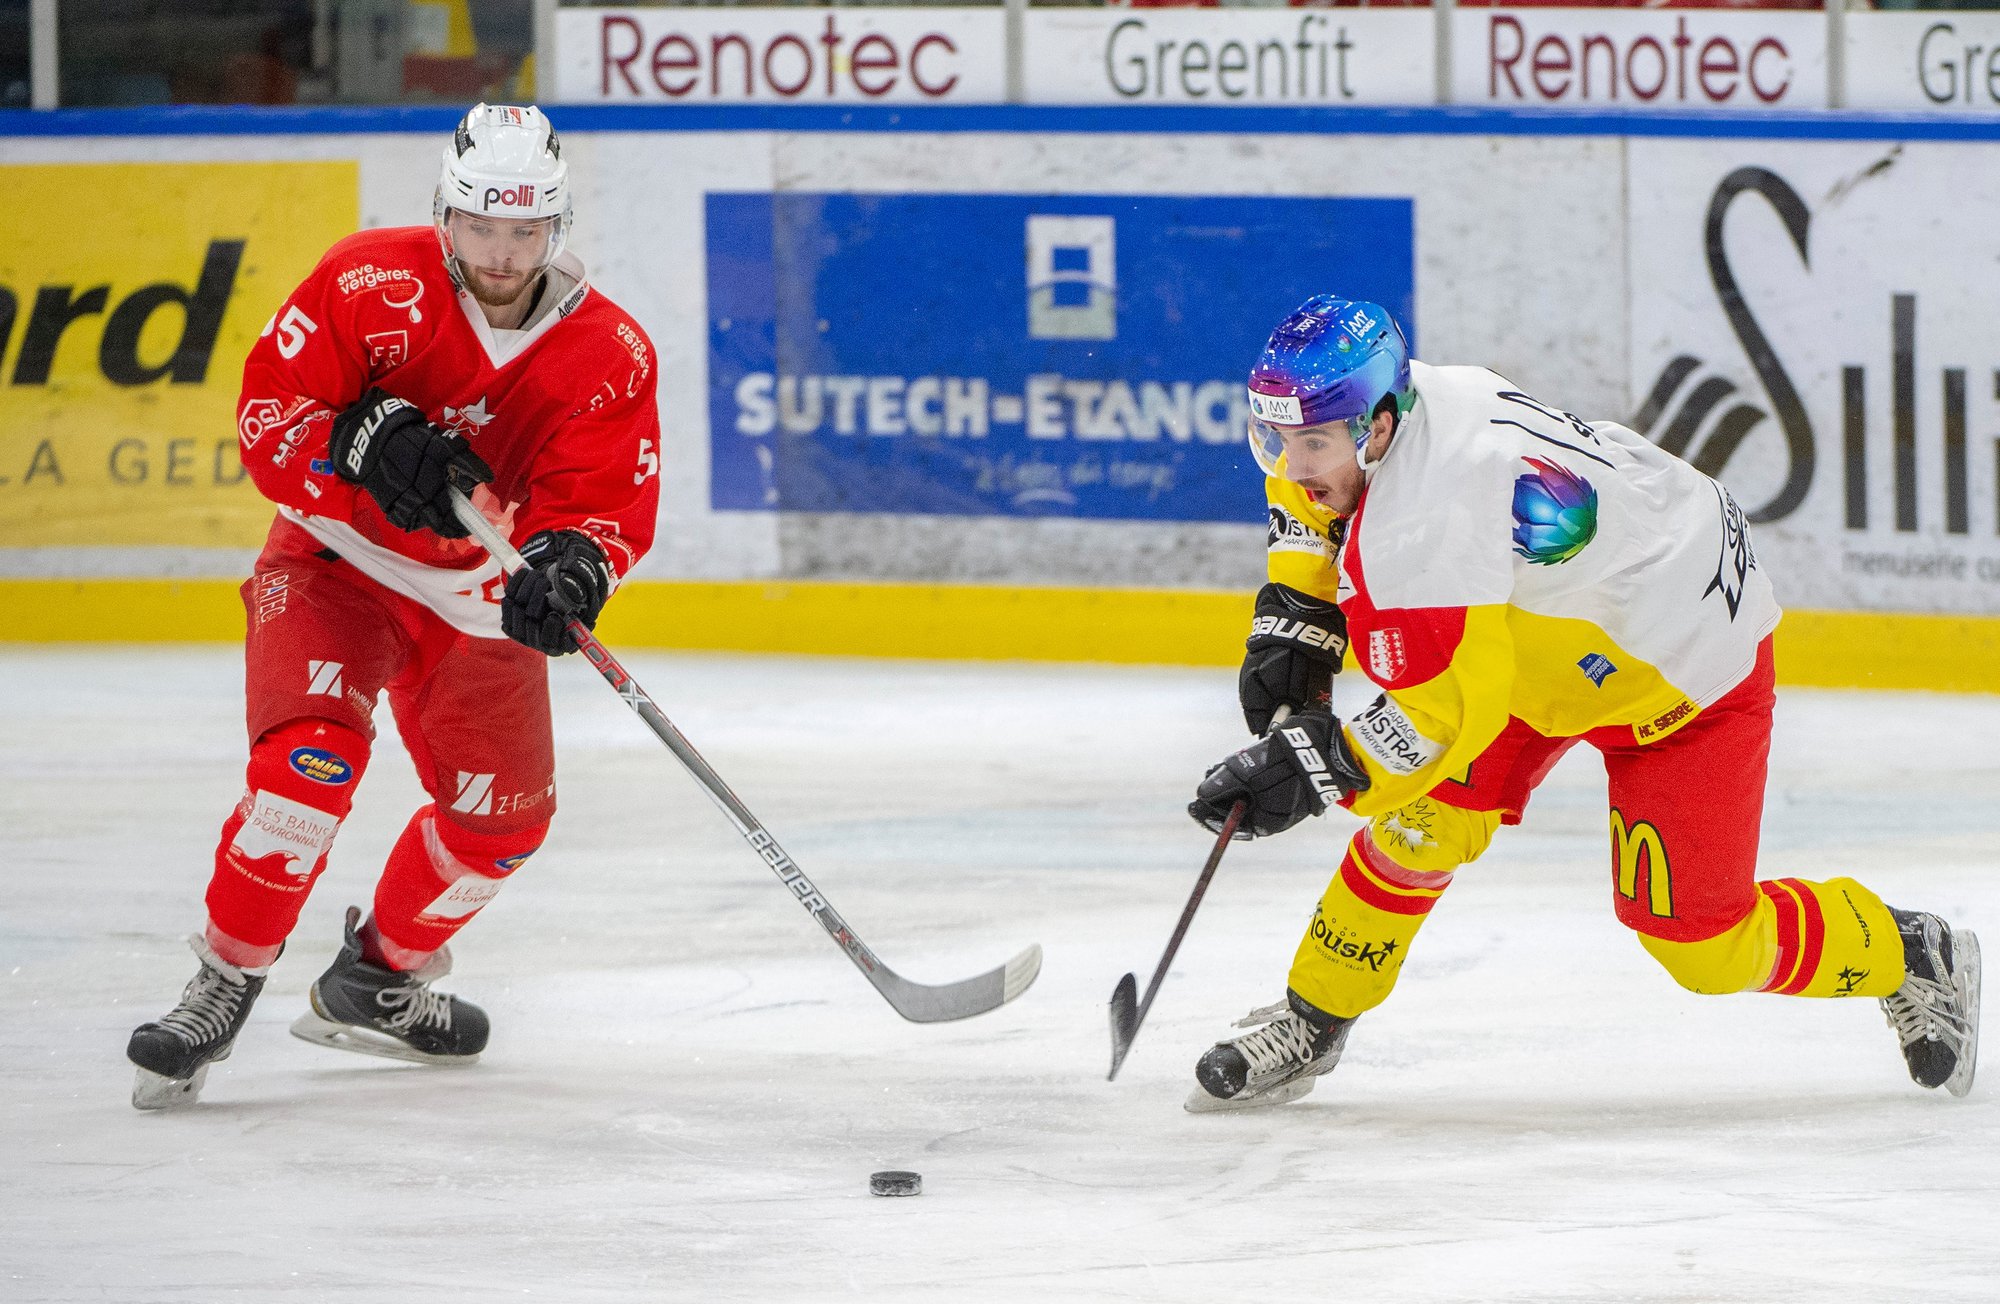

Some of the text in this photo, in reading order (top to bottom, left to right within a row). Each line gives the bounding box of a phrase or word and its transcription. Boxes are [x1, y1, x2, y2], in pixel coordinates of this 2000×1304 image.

[602, 14, 958, 97] Renotec
[1105, 14, 1355, 98] Greenfit
[1488, 14, 1789, 101] Renotec
[483, 184, 535, 211] polli
[337, 263, 374, 286] steve
[340, 267, 411, 295] vergères
[0, 238, 247, 388] rd
[1348, 308, 1370, 333] MY
[734, 371, 1249, 444] SUTECH-ETANC
[1268, 400, 1291, 413] MY
[1251, 615, 1346, 658] BAUER
[1385, 705, 1420, 746] GARAGE
[1638, 700, 1694, 739] HC SIERRE
[1358, 724, 1391, 760] MARTIGNY
[296, 753, 346, 776] CHIP
[304, 768, 332, 781] SPORT
[258, 803, 331, 838] LES BAINS
[748, 828, 827, 917] BAUER
